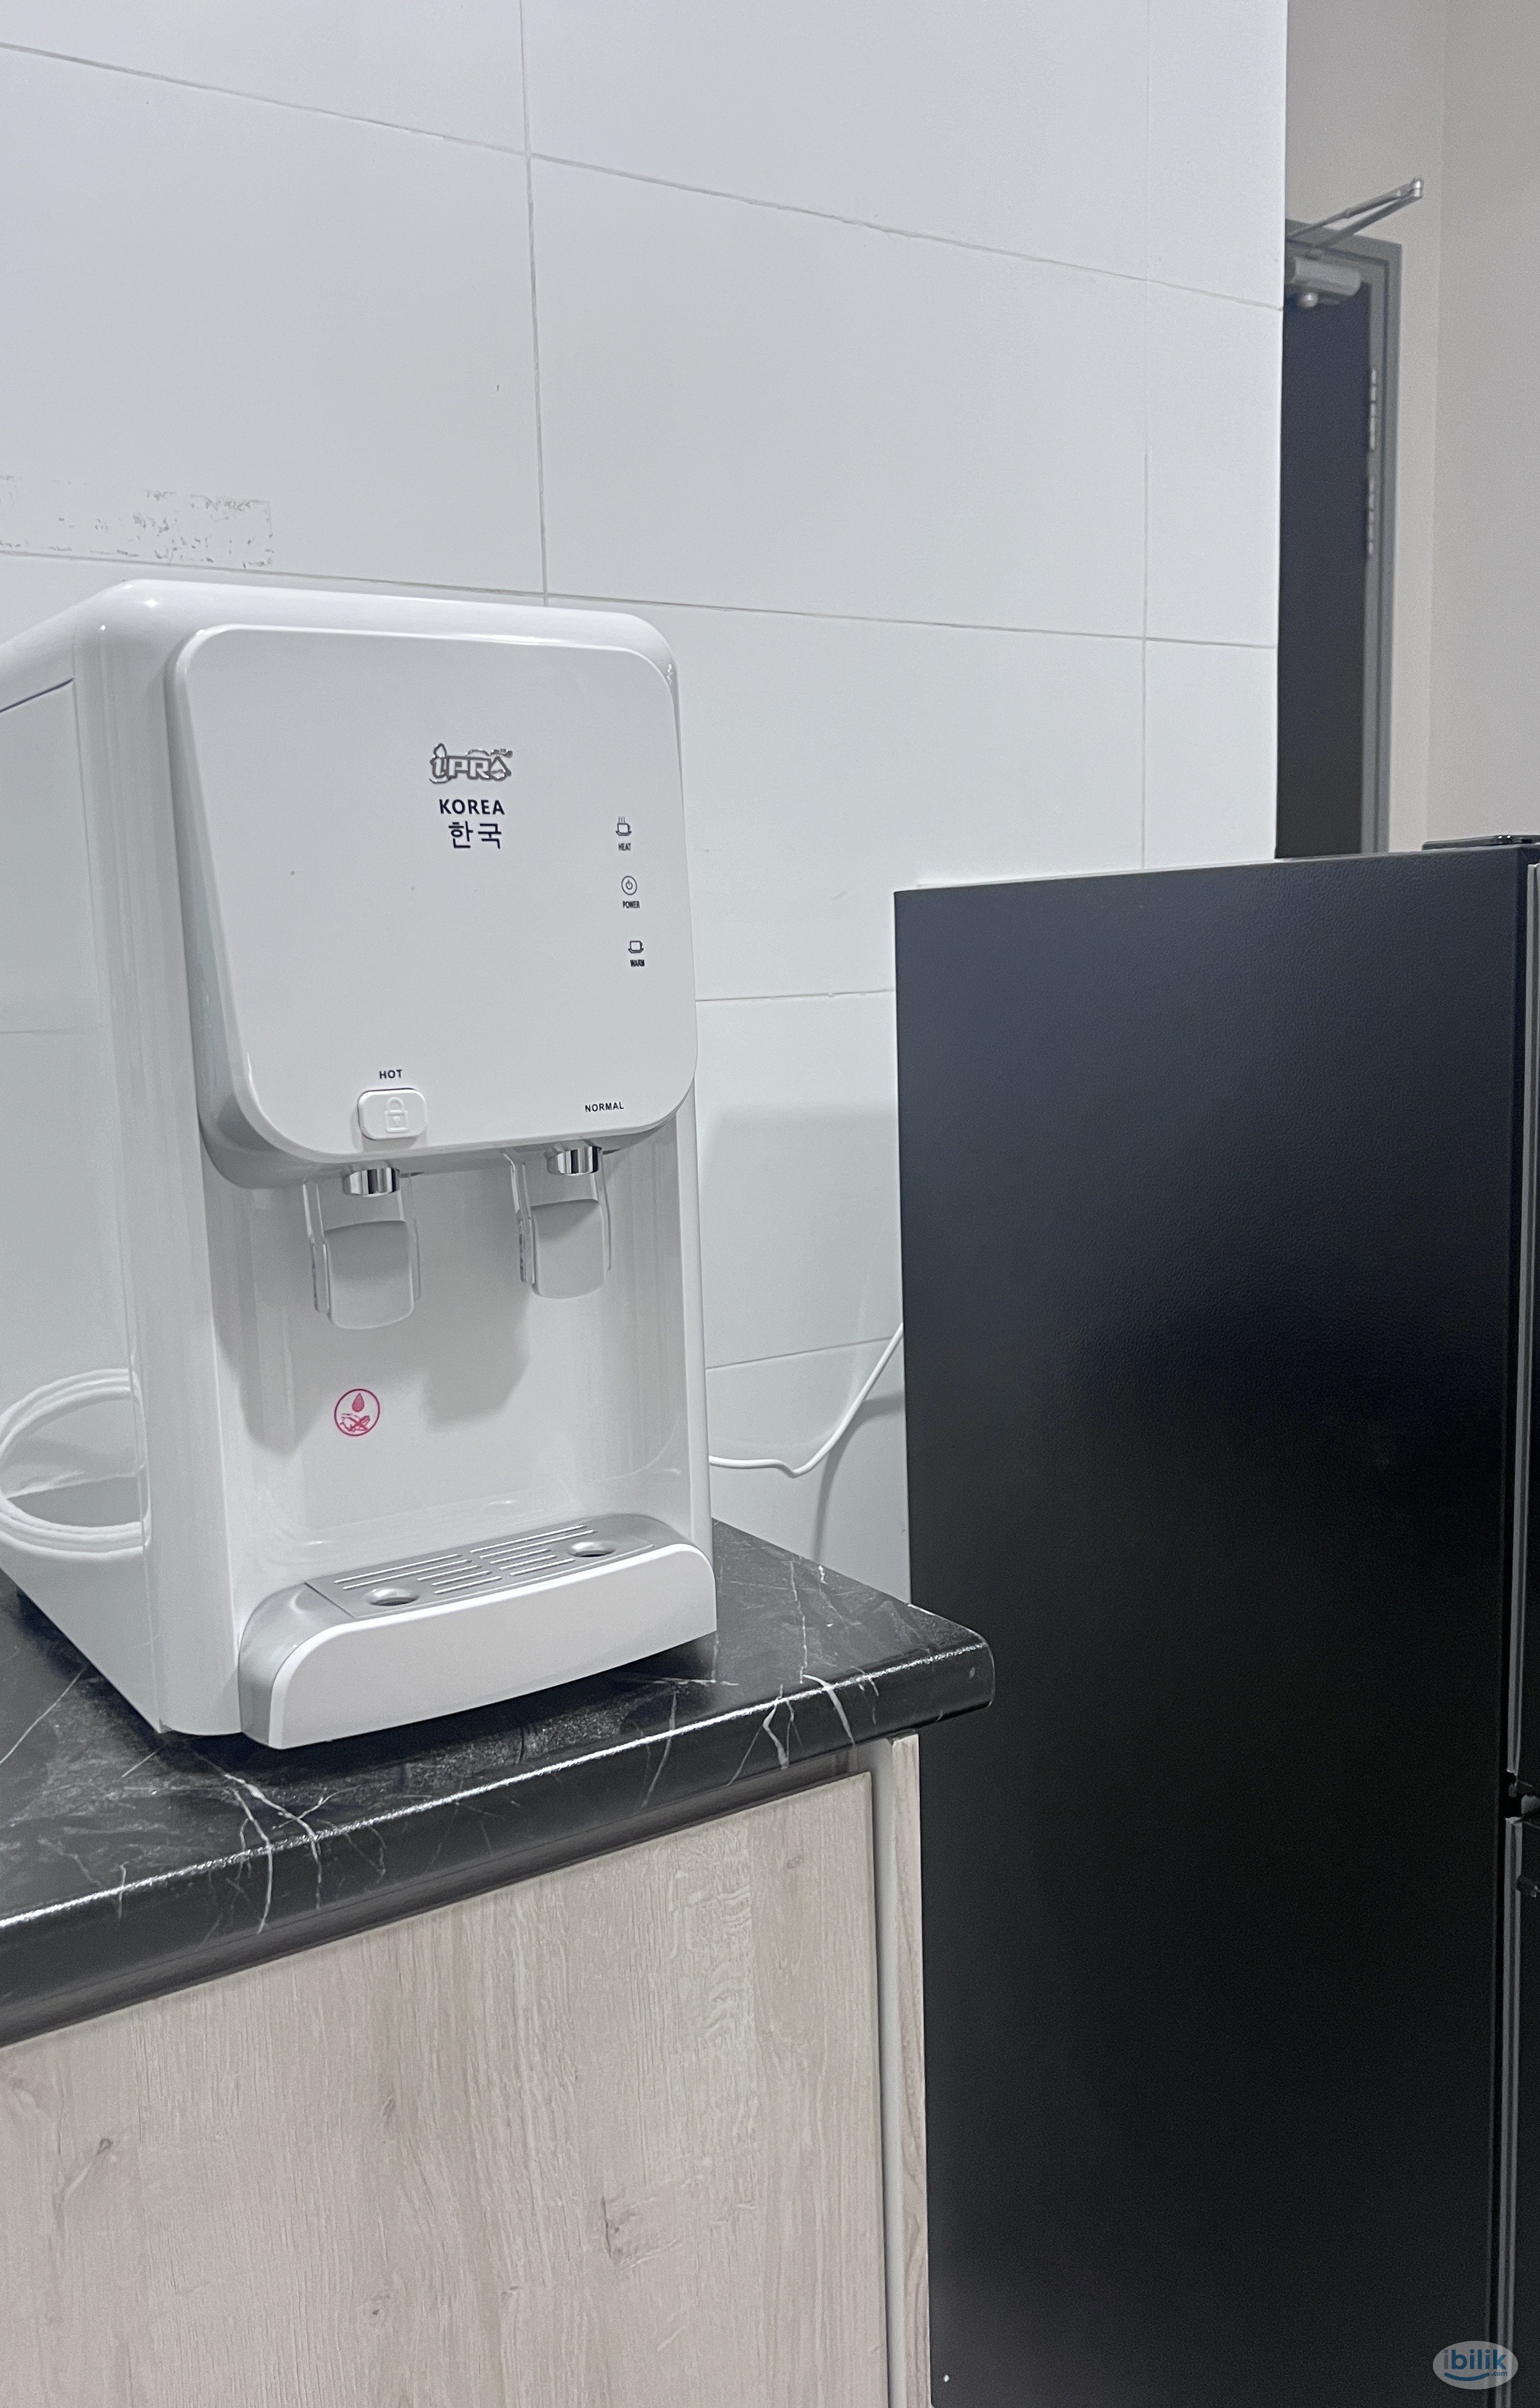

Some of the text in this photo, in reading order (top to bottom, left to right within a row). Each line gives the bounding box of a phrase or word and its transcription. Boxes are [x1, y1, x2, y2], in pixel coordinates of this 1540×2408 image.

[439, 799, 505, 815] KOREA
[448, 820, 502, 849] 한국
[623, 900, 640, 909] POWER
[379, 1069, 403, 1079] HOT
[585, 1101, 624, 1113] NORMAL
